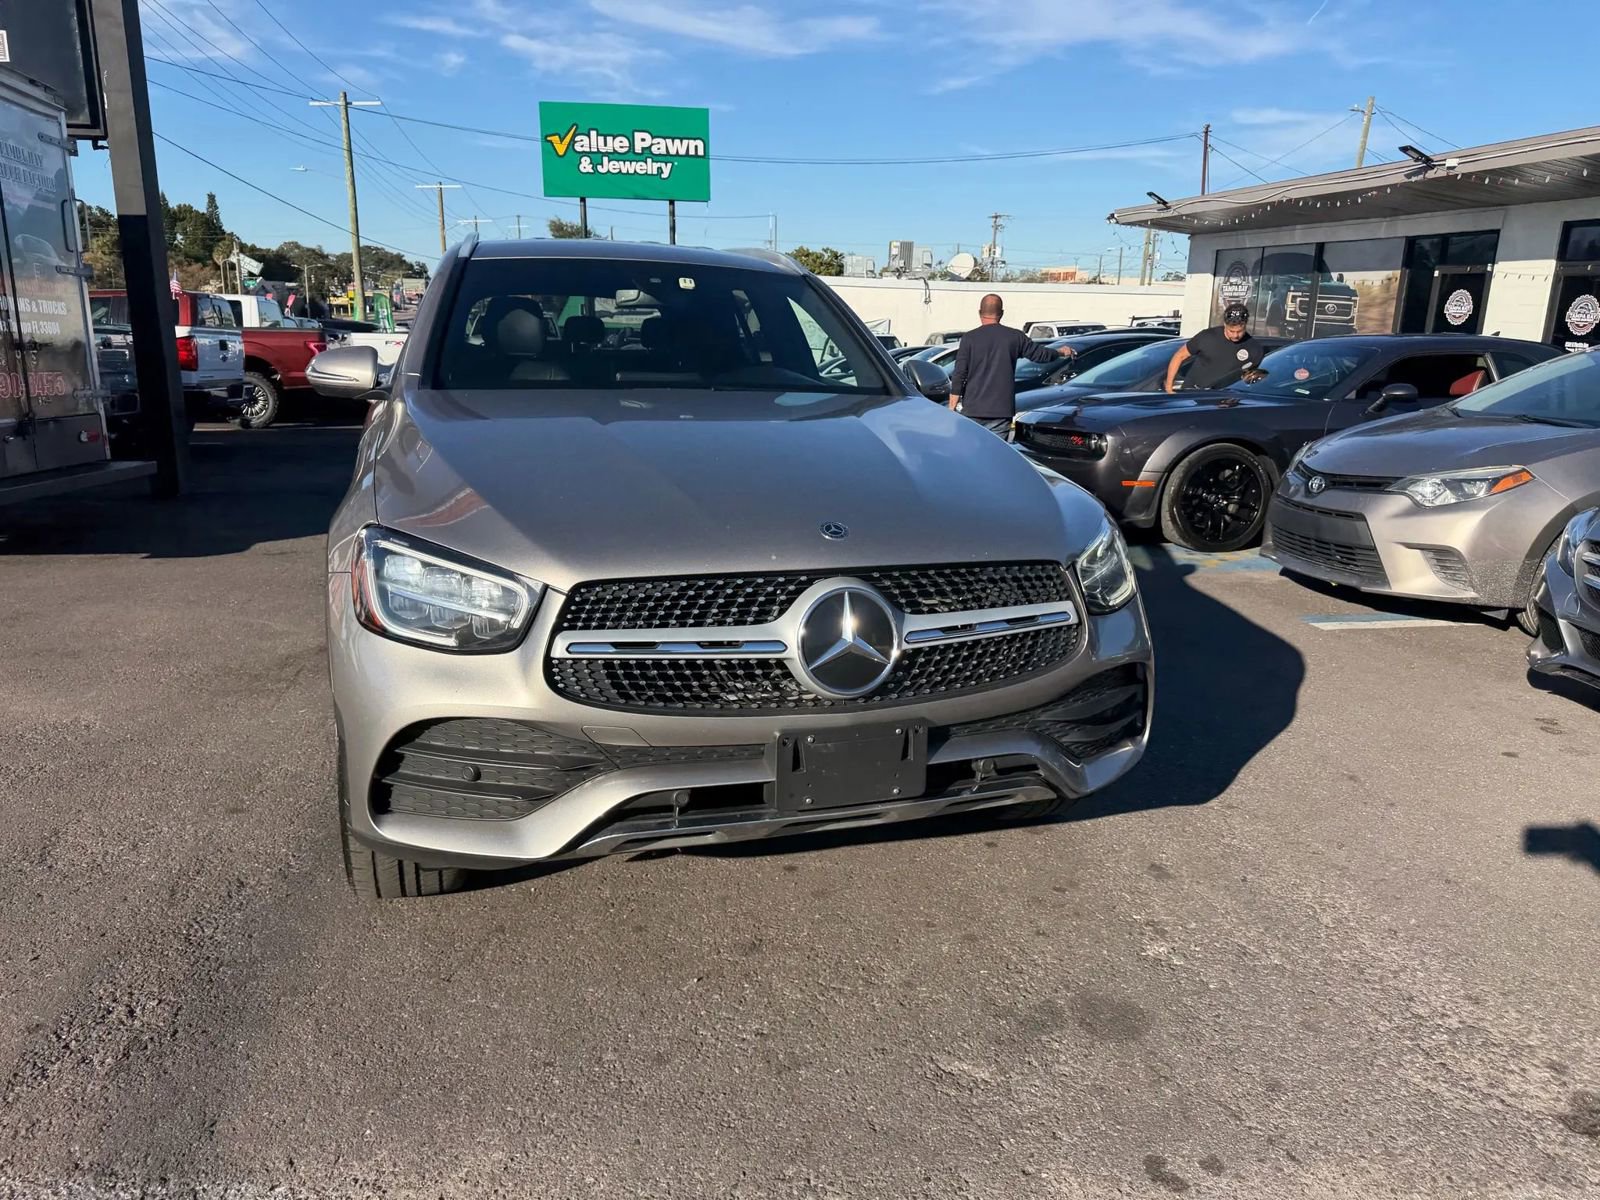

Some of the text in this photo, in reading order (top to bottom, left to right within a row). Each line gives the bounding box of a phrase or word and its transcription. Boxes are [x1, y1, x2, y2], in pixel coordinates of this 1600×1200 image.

[633, 131, 705, 156] Pawn
[579, 155, 673, 179] & Jewelry
[38, 299, 67, 315] TRUCKS
